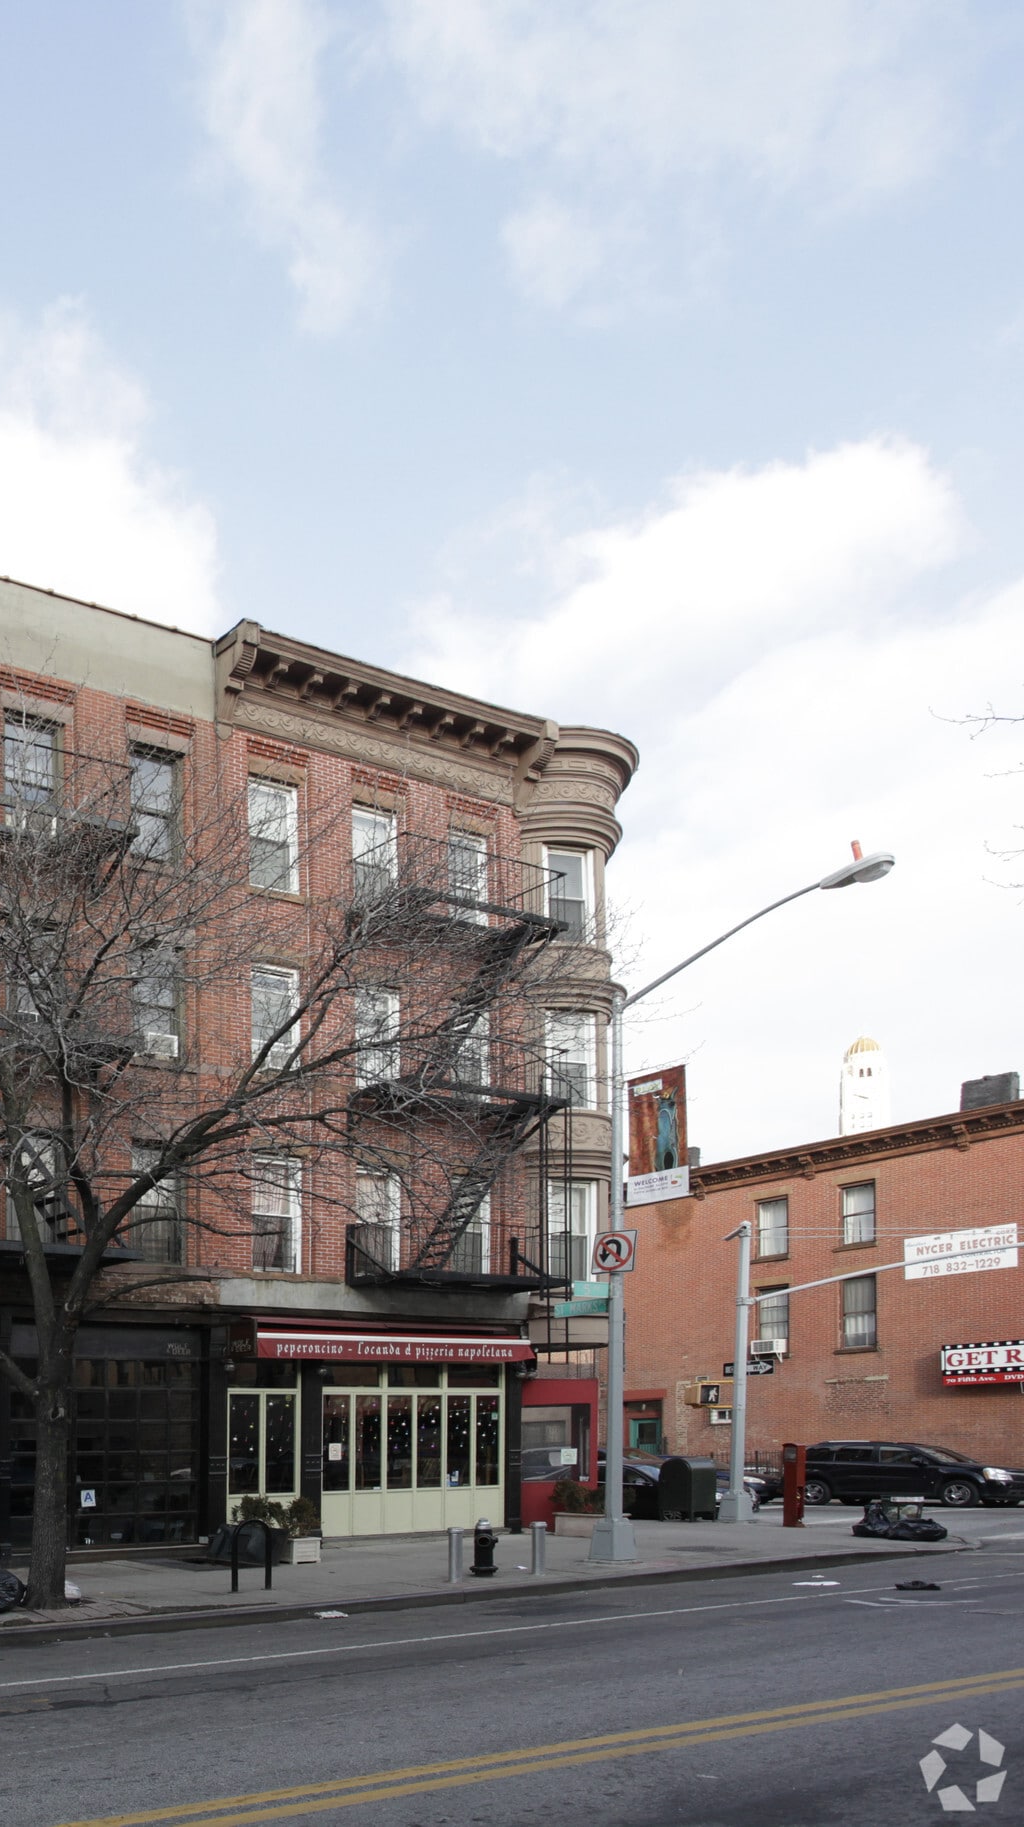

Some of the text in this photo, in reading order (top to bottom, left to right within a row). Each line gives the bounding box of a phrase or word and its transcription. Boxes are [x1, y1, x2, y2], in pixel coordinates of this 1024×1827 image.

[634, 1175, 669, 1187] WELCOME
[916, 1242, 953, 1256] NYCER
[959, 1234, 1015, 1250] ELECTRIC
[922, 1257, 1001, 1276] 718 832-1229
[276, 1341, 344, 1357] peperoncino
[946, 1350, 998, 1367] GET
[753, 1363, 767, 1371] WAY
[84, 1491, 94, 1502] A
